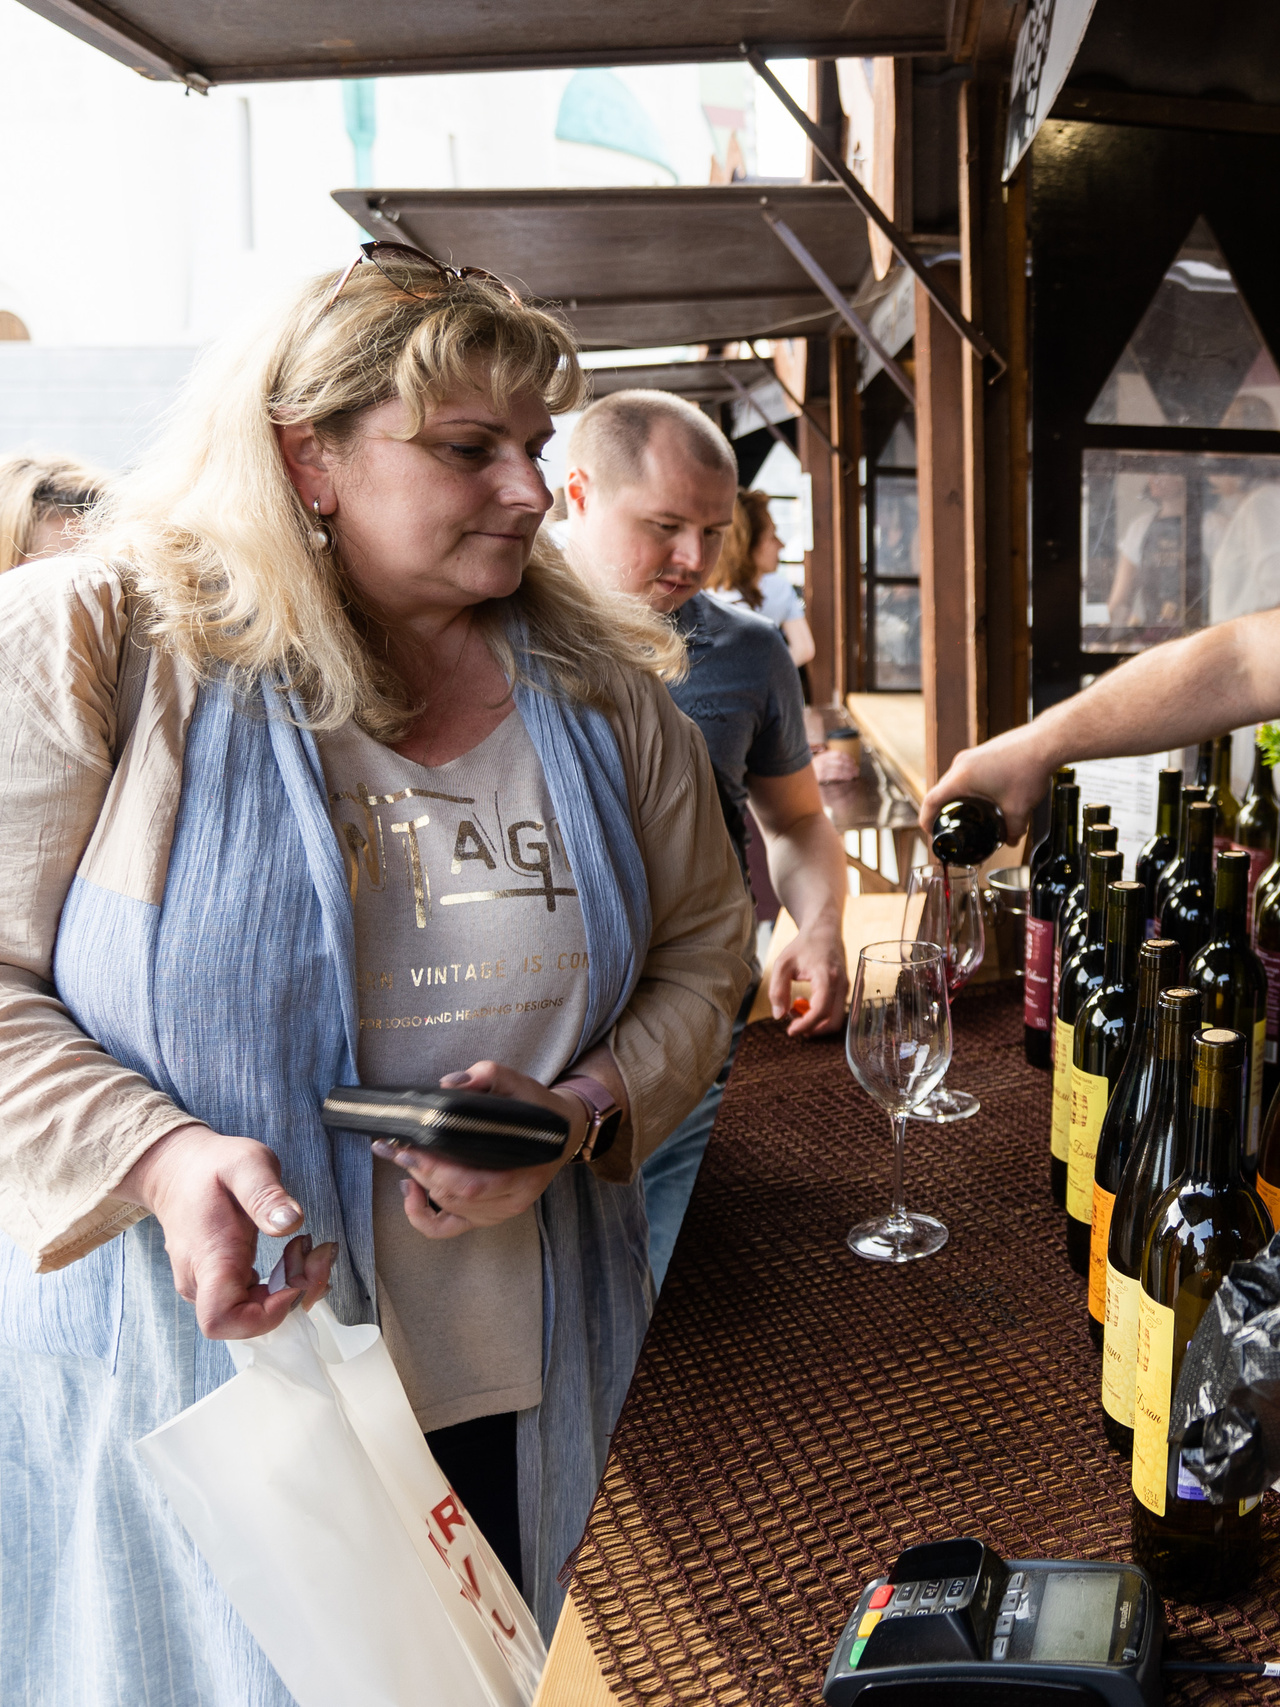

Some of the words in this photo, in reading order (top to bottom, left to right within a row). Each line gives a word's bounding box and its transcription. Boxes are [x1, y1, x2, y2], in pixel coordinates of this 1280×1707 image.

[410, 959, 507, 987] VINTAGE
[523, 954, 543, 974] IS
[359, 1018, 382, 1030] FOR
[385, 1015, 422, 1029] LOGO
[424, 1012, 452, 1026] AND
[455, 1003, 512, 1021] HEADING
[515, 997, 564, 1014] DESIGNS
